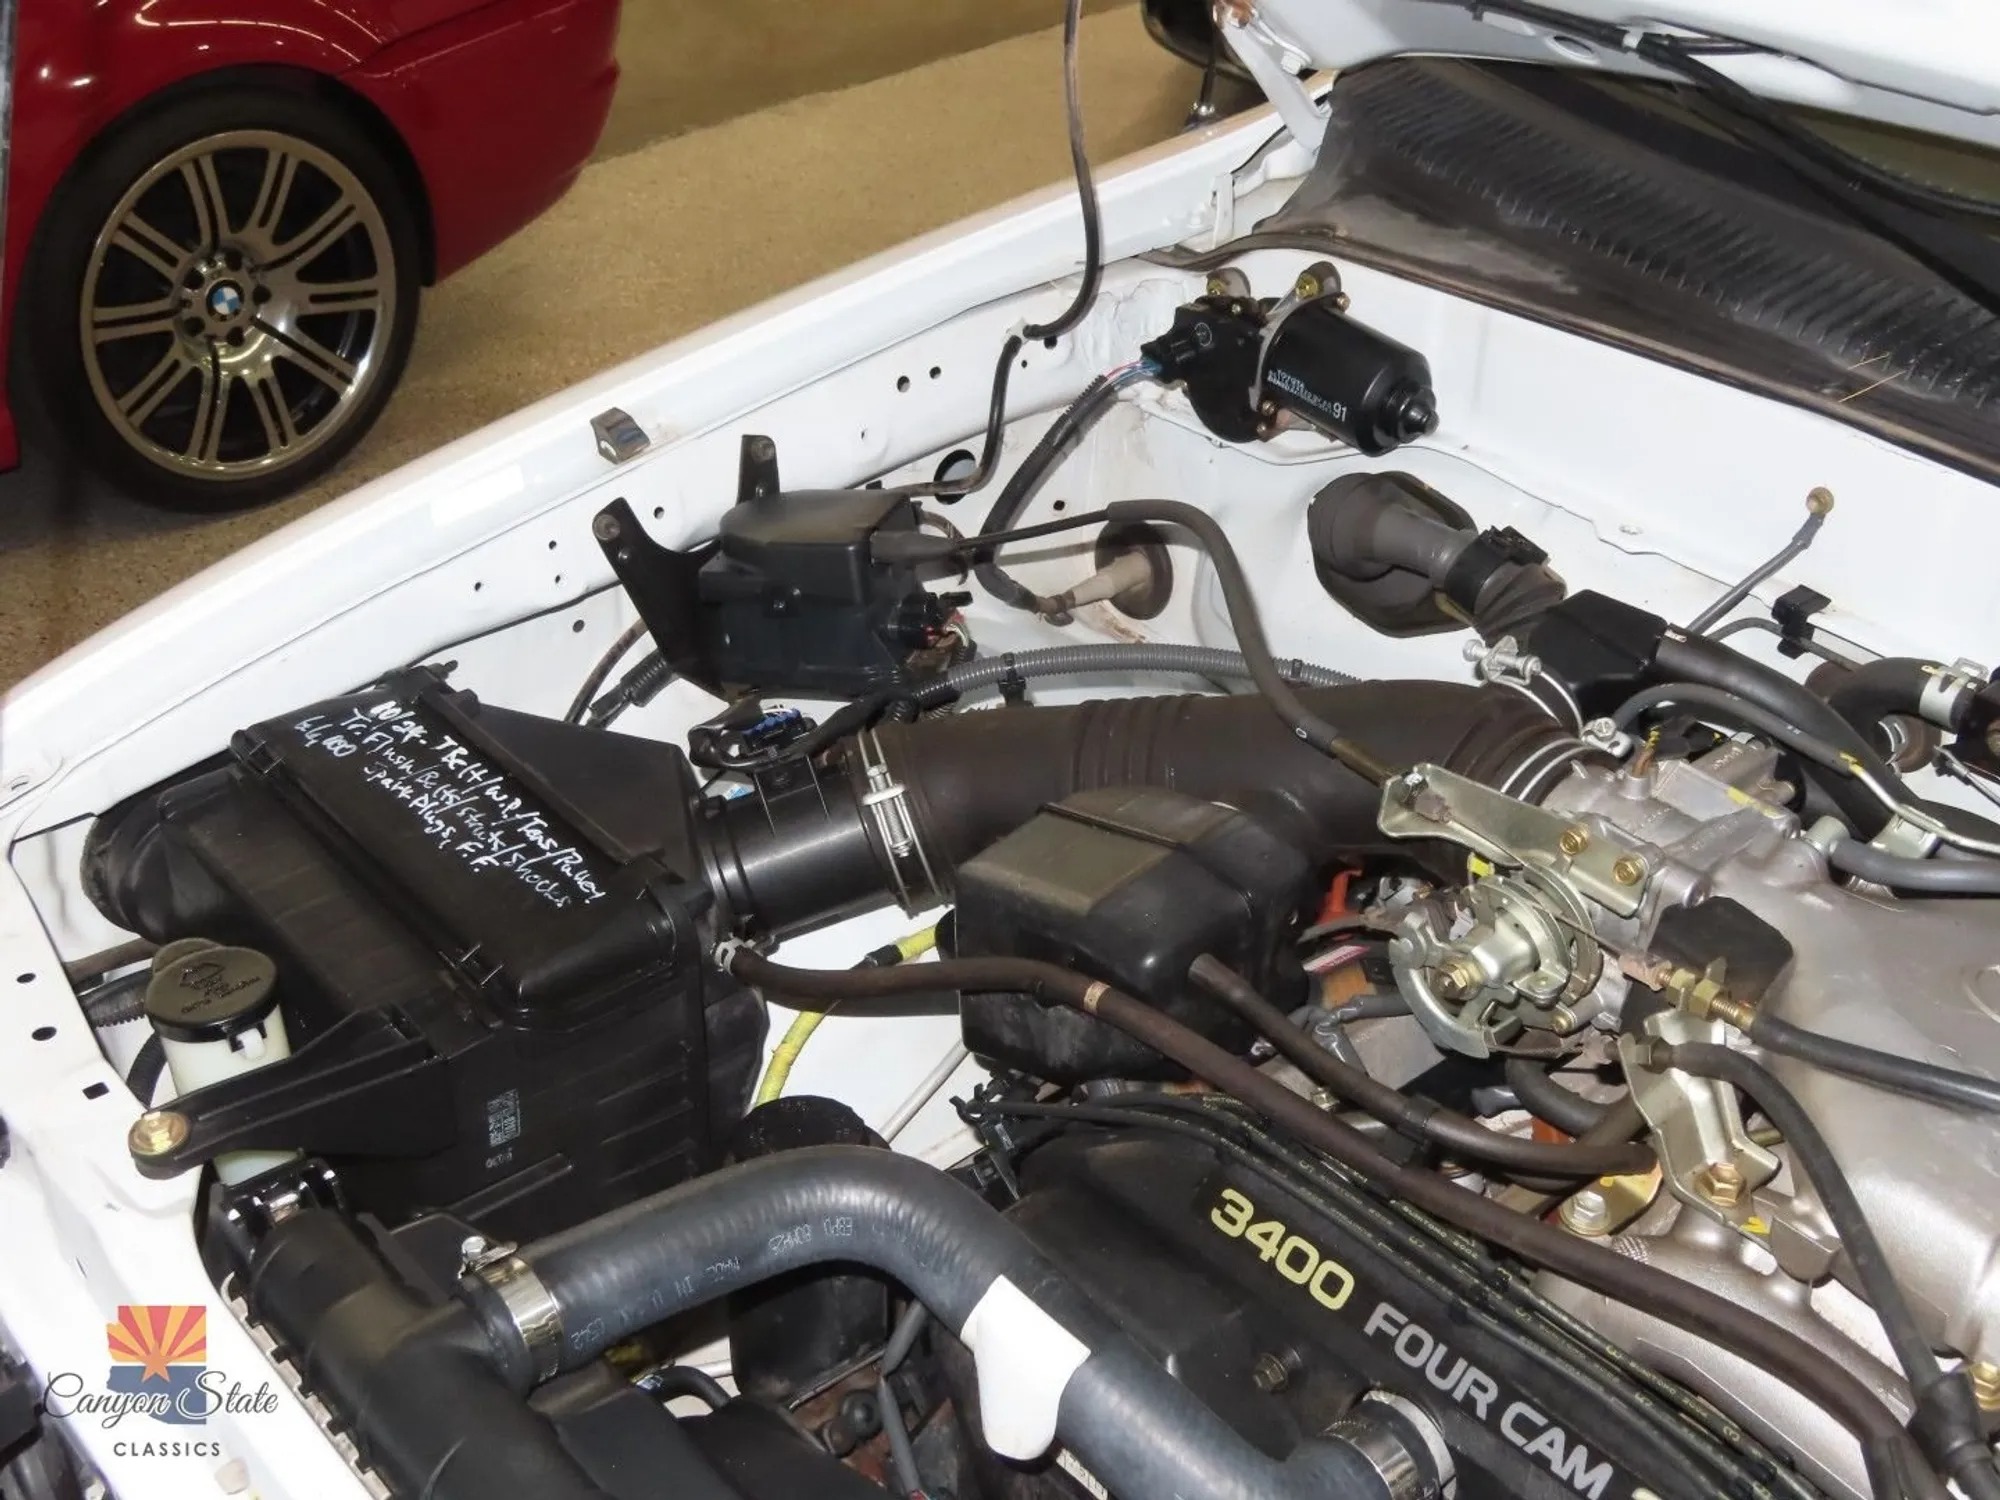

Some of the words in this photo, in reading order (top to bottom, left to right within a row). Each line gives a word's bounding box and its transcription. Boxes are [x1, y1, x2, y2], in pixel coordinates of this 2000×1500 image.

[1333, 402, 1347, 422] 91
[1211, 1188, 1356, 1311] 3400
[1363, 1302, 1500, 1420] FOUR
[1500, 1402, 1613, 1500] CAM
